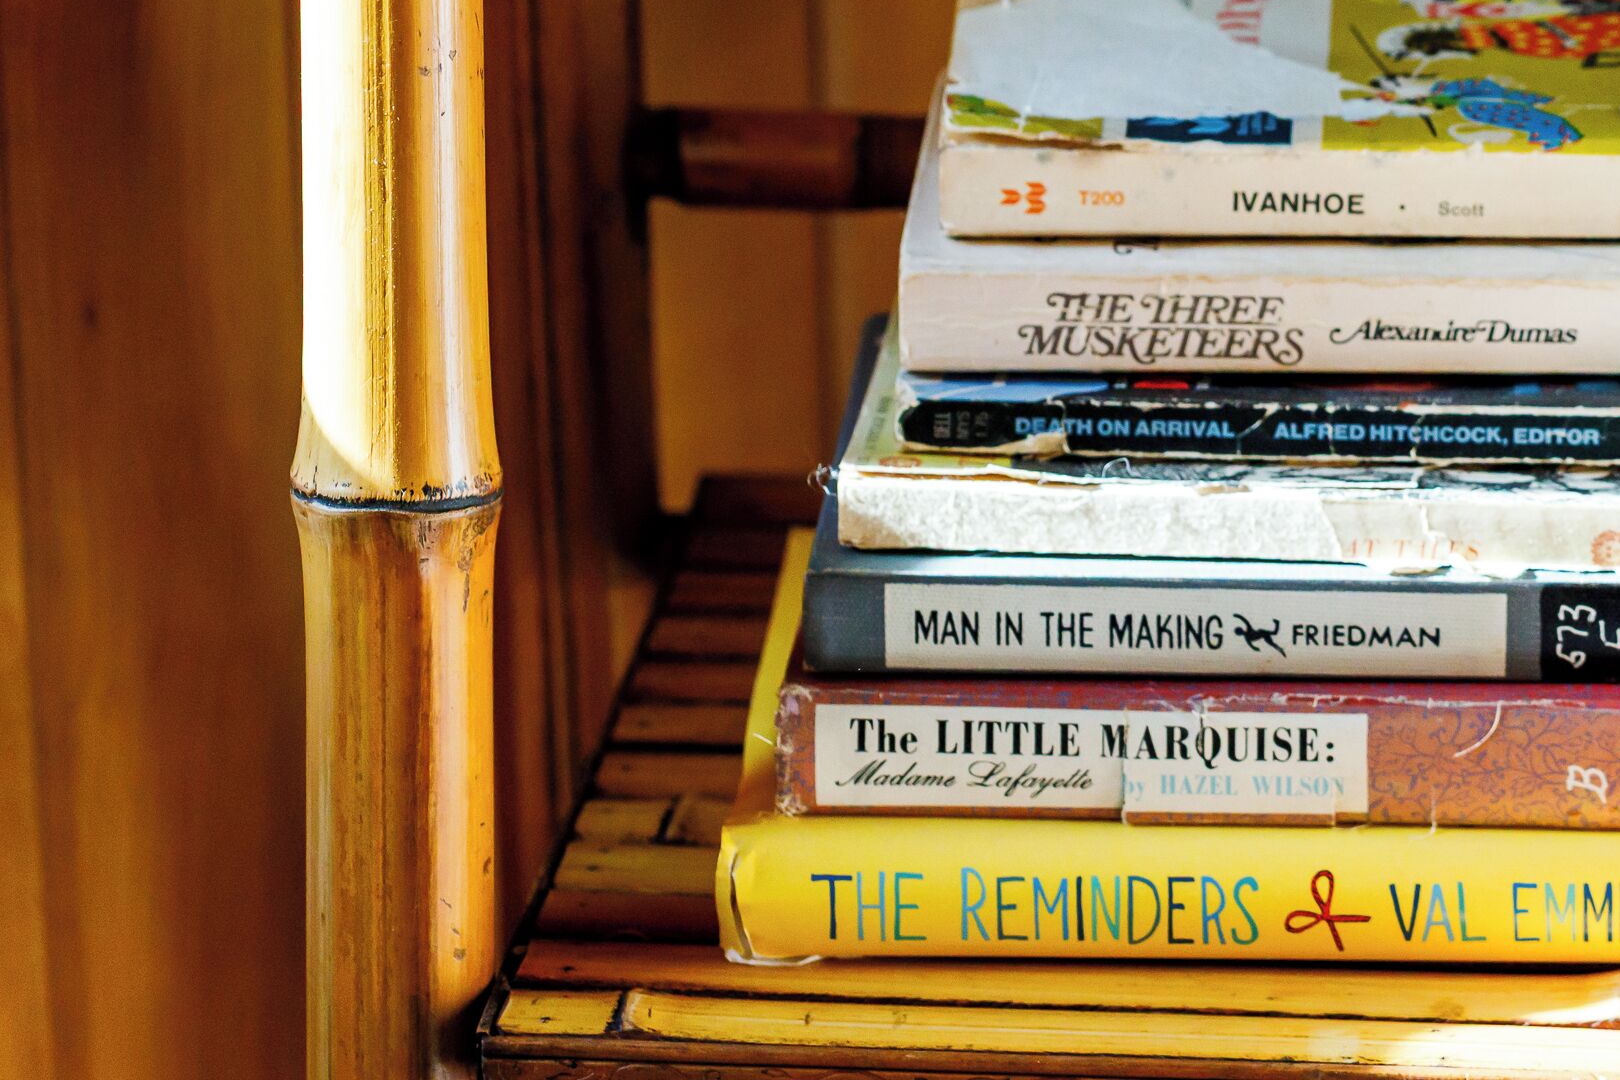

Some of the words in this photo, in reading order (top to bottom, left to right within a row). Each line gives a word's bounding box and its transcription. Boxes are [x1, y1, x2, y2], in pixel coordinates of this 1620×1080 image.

[1078, 190, 1126, 207] T200
[1231, 190, 1365, 215] IVANHOE
[1437, 200, 1486, 218] Scott
[1046, 291, 1135, 324] THE
[1140, 293, 1285, 326] THREE
[1017, 324, 1305, 366] MUSKETEERS
[1478, 319, 1579, 344] Dumas
[1014, 416, 1092, 438] DEATH
[1096, 418, 1131, 438] ON
[1135, 418, 1236, 439] ARRIVAL
[1273, 421, 1365, 441] ALFRED
[1369, 423, 1509, 446] HITCHCOCK,
[1512, 427, 1600, 446] EDITOR
[914, 609, 980, 646] MAN
[995, 611, 1024, 647] IN
[1040, 611, 1095, 648] THE
[1108, 613, 1224, 651] MAKING
[1292, 623, 1441, 649] FRIEDMAN
[849, 717, 919, 755] The
[936, 719, 1081, 757] LITTLE
[1100, 723, 1336, 770] MARQUISE:
[834, 759, 957, 788] Madame
[966, 759, 1094, 799] Lafayette
[1121, 772, 1146, 800] by
[1159, 774, 1239, 797] HAZEL
[1251, 775, 1345, 797] WILSON
[810, 870, 928, 942] THE
[960, 866, 1260, 946] REMINDERS
[1388, 881, 1487, 943] VAL
